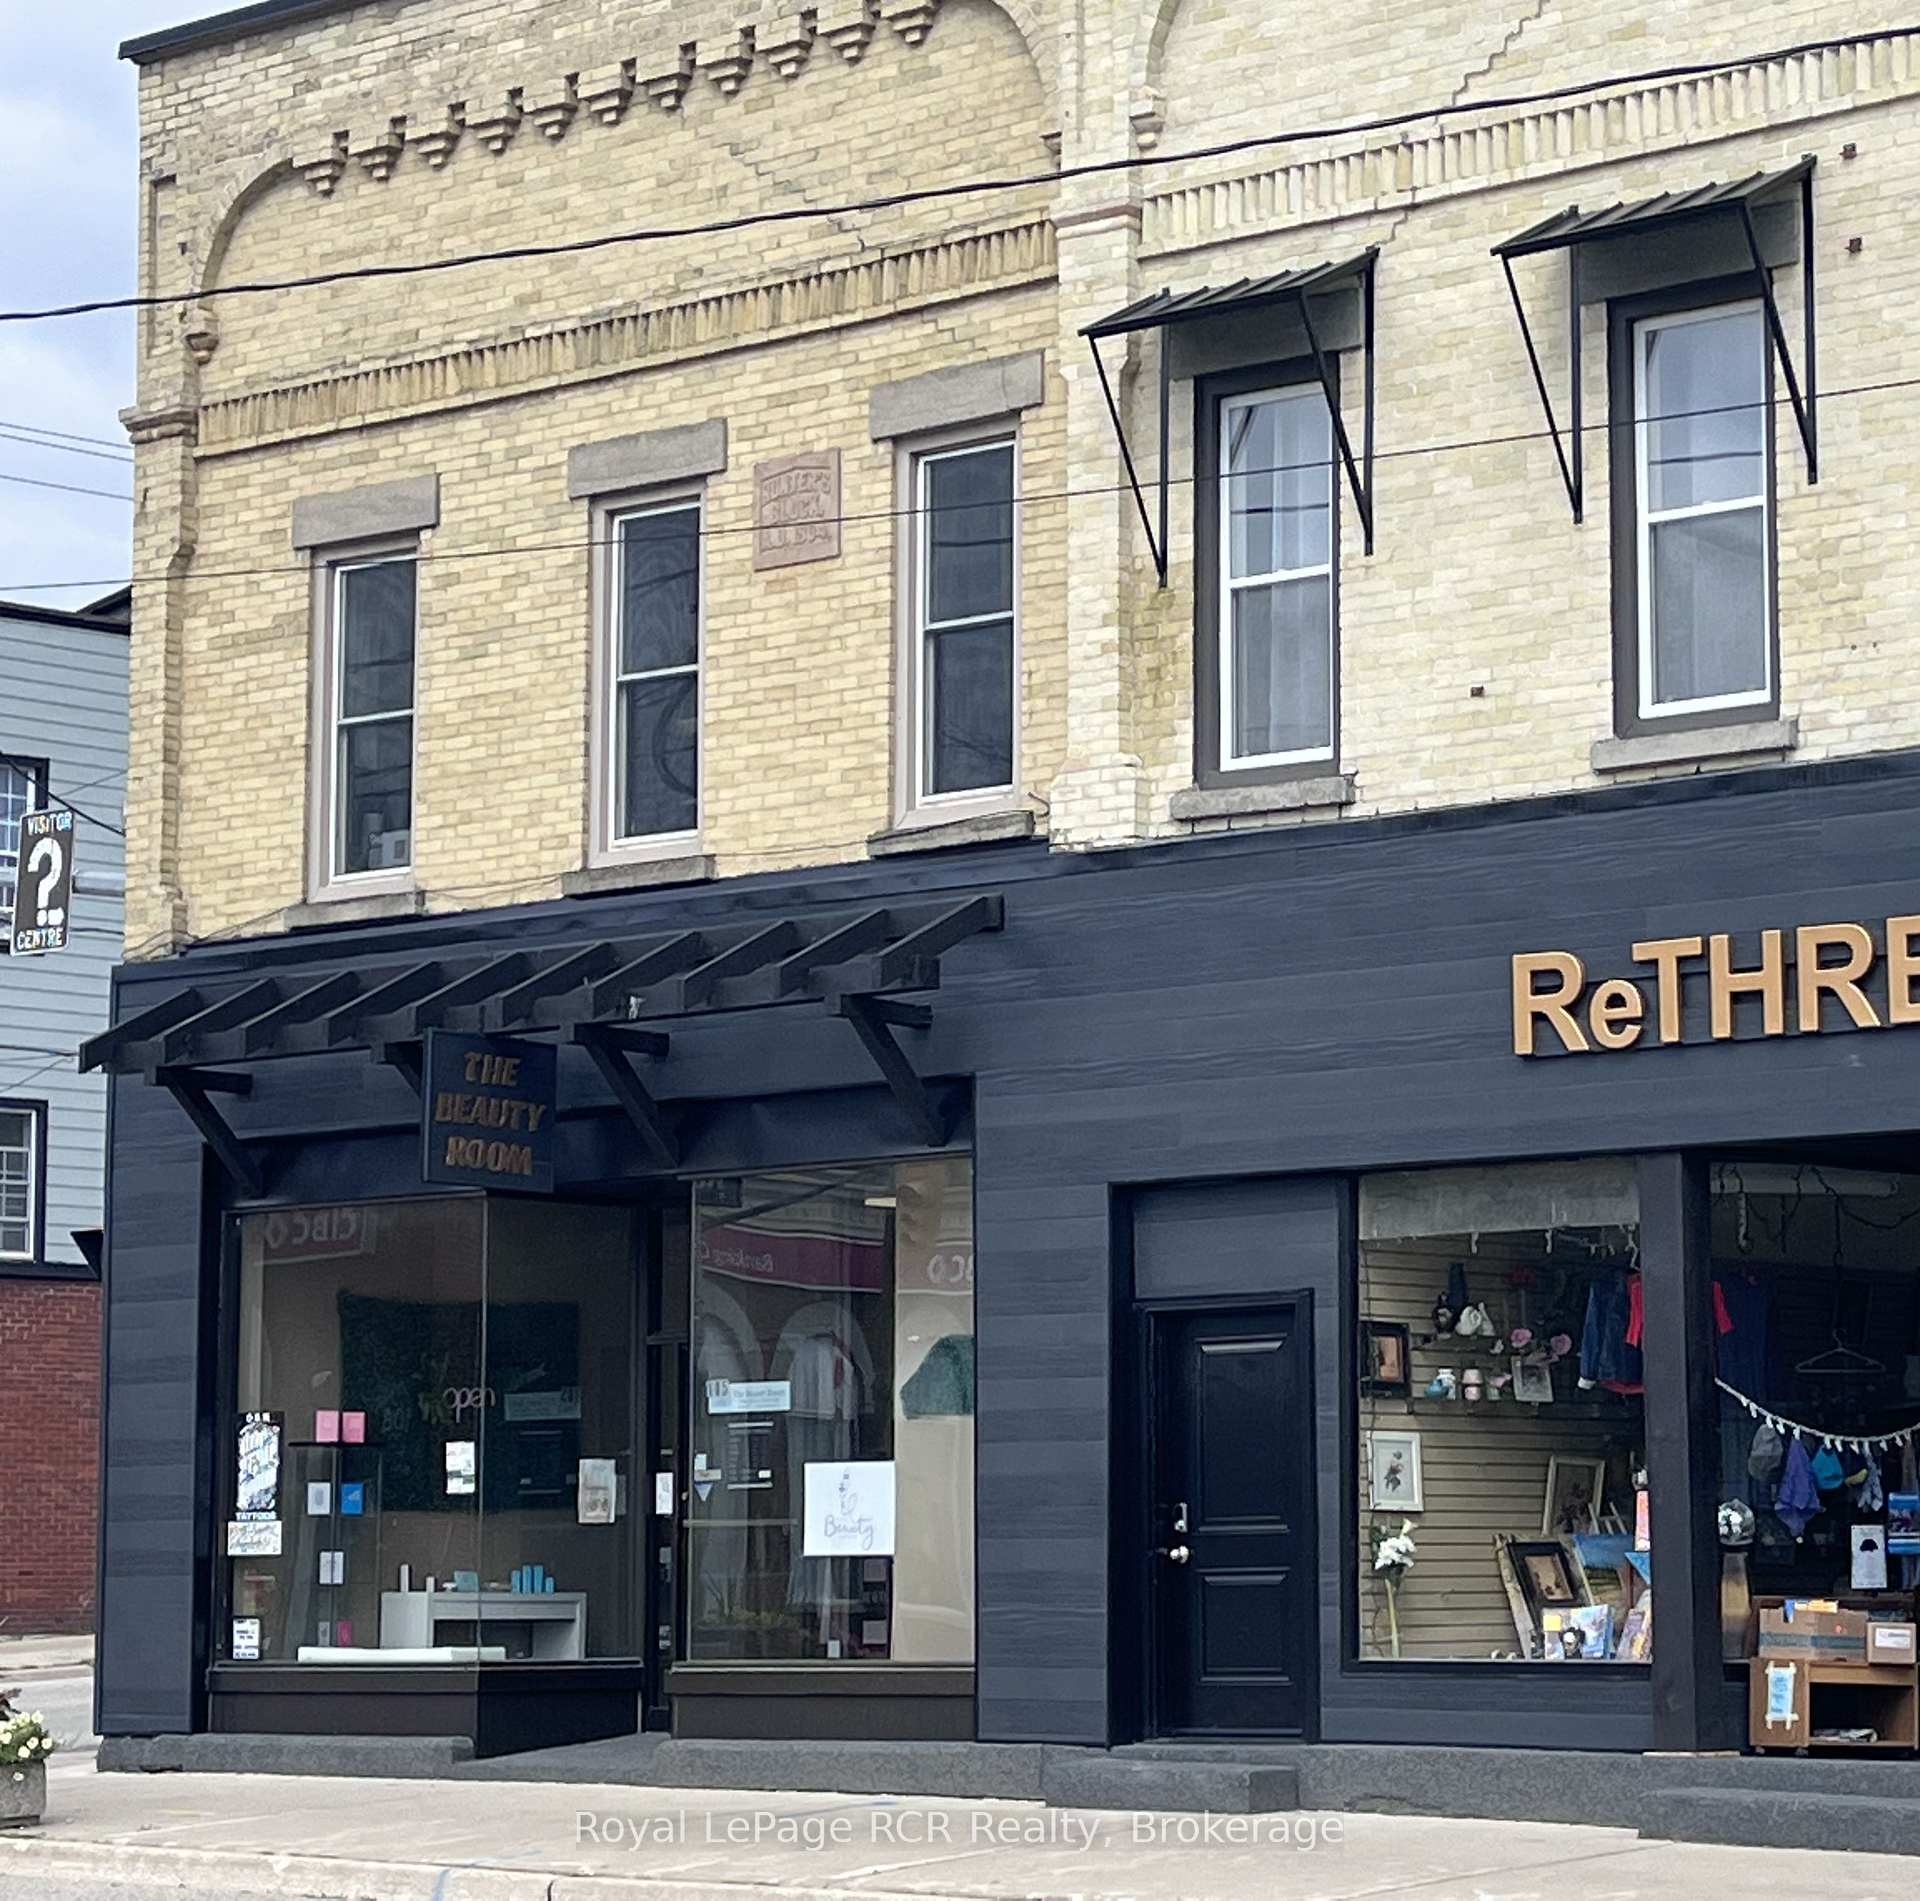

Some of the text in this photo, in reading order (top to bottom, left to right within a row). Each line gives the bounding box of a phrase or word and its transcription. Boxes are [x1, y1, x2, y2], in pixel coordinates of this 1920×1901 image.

[27, 811, 73, 835] VISITOR
[16, 926, 64, 951] CENTRE
[463, 1051, 522, 1087] THE
[434, 1091, 547, 1133] BEAUTY
[445, 1135, 533, 1176] ROOM
[443, 1386, 497, 1424] open
